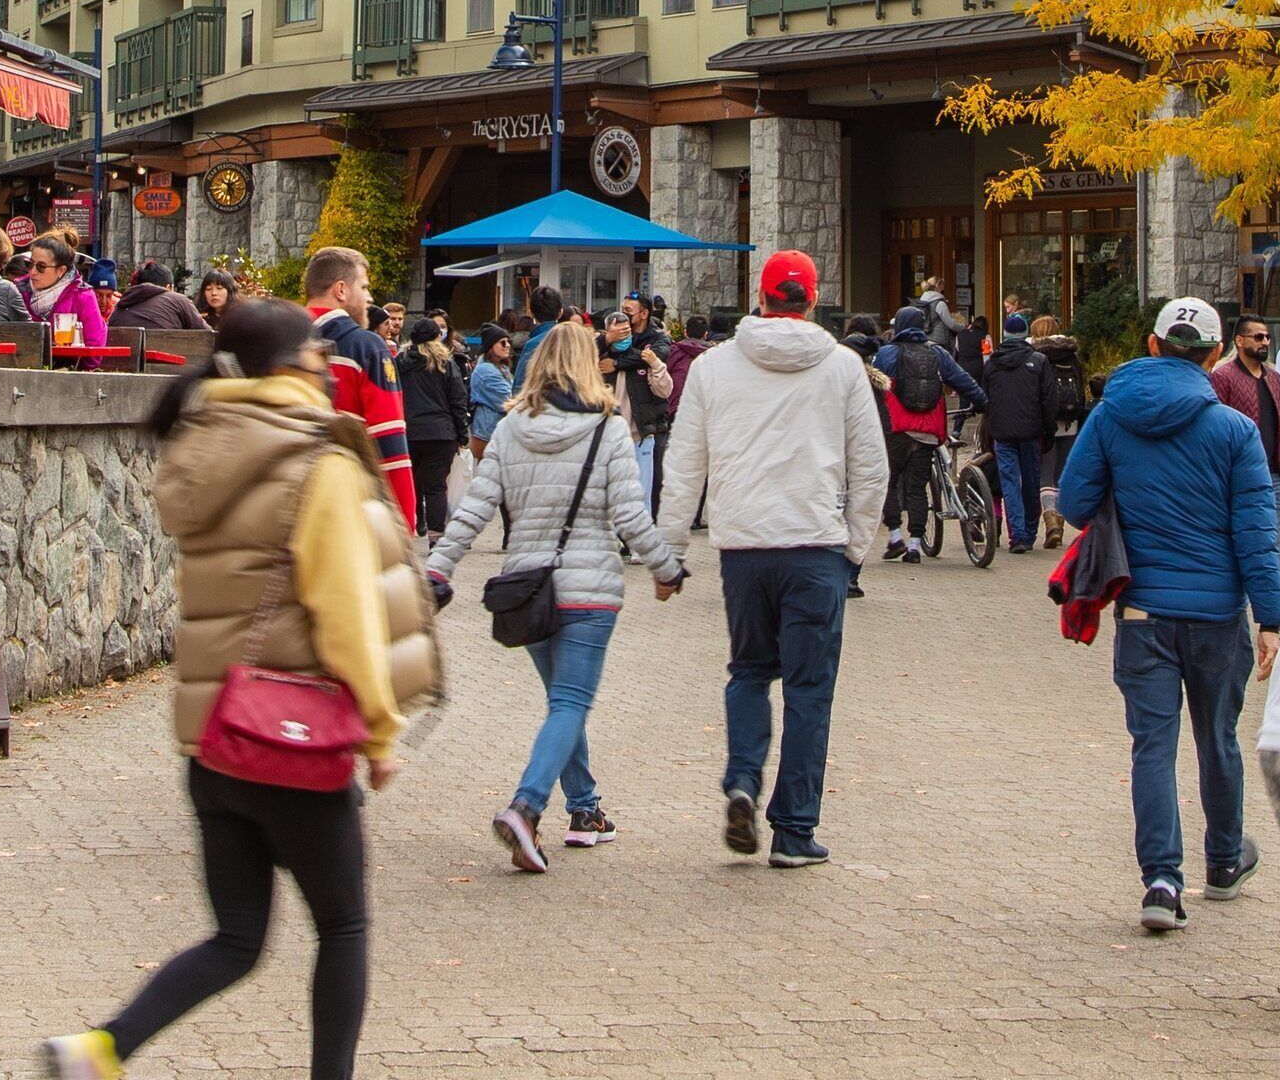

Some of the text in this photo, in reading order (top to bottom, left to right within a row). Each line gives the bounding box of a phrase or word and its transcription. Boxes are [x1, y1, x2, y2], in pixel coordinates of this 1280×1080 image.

[486, 113, 554, 139] CRYSTA
[597, 131, 616, 157] ROCKS
[624, 135, 639, 158] GEMS
[603, 178, 633, 193] CANADA
[1060, 174, 1071, 188] &
[1076, 172, 1115, 187] GEMS
[143, 192, 172, 202] SMILE
[145, 203, 170, 211] GIFT
[10, 221, 27, 229] JEEP
[8, 228, 26, 236] BEAR
[11, 233, 34, 242] TOURS
[1176, 307, 1199, 322] 27
